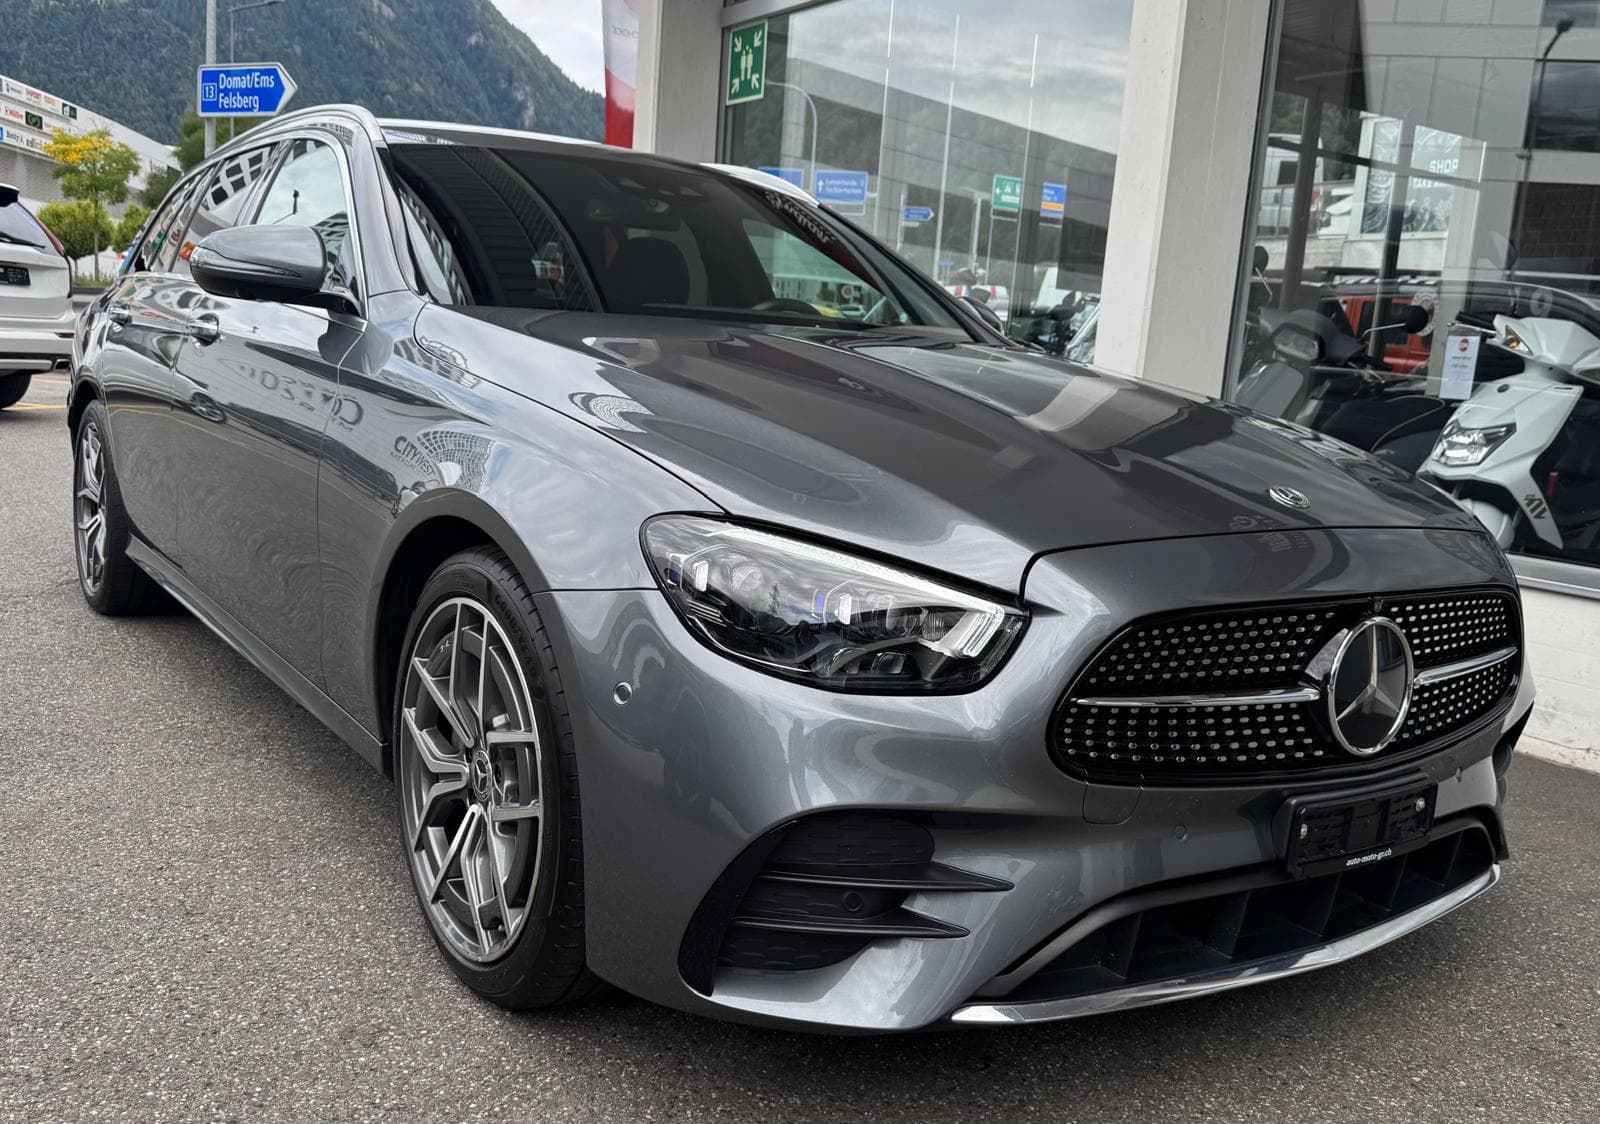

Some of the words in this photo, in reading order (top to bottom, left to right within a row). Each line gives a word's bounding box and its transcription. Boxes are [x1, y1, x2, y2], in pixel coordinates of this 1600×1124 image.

[218, 72, 275, 89] Domat/Ems
[205, 86, 215, 99] 13
[218, 92, 260, 113] Felsberg
[1429, 159, 1460, 174] SHOP
[1346, 848, 1392, 866] auto-moto-gr.ch
